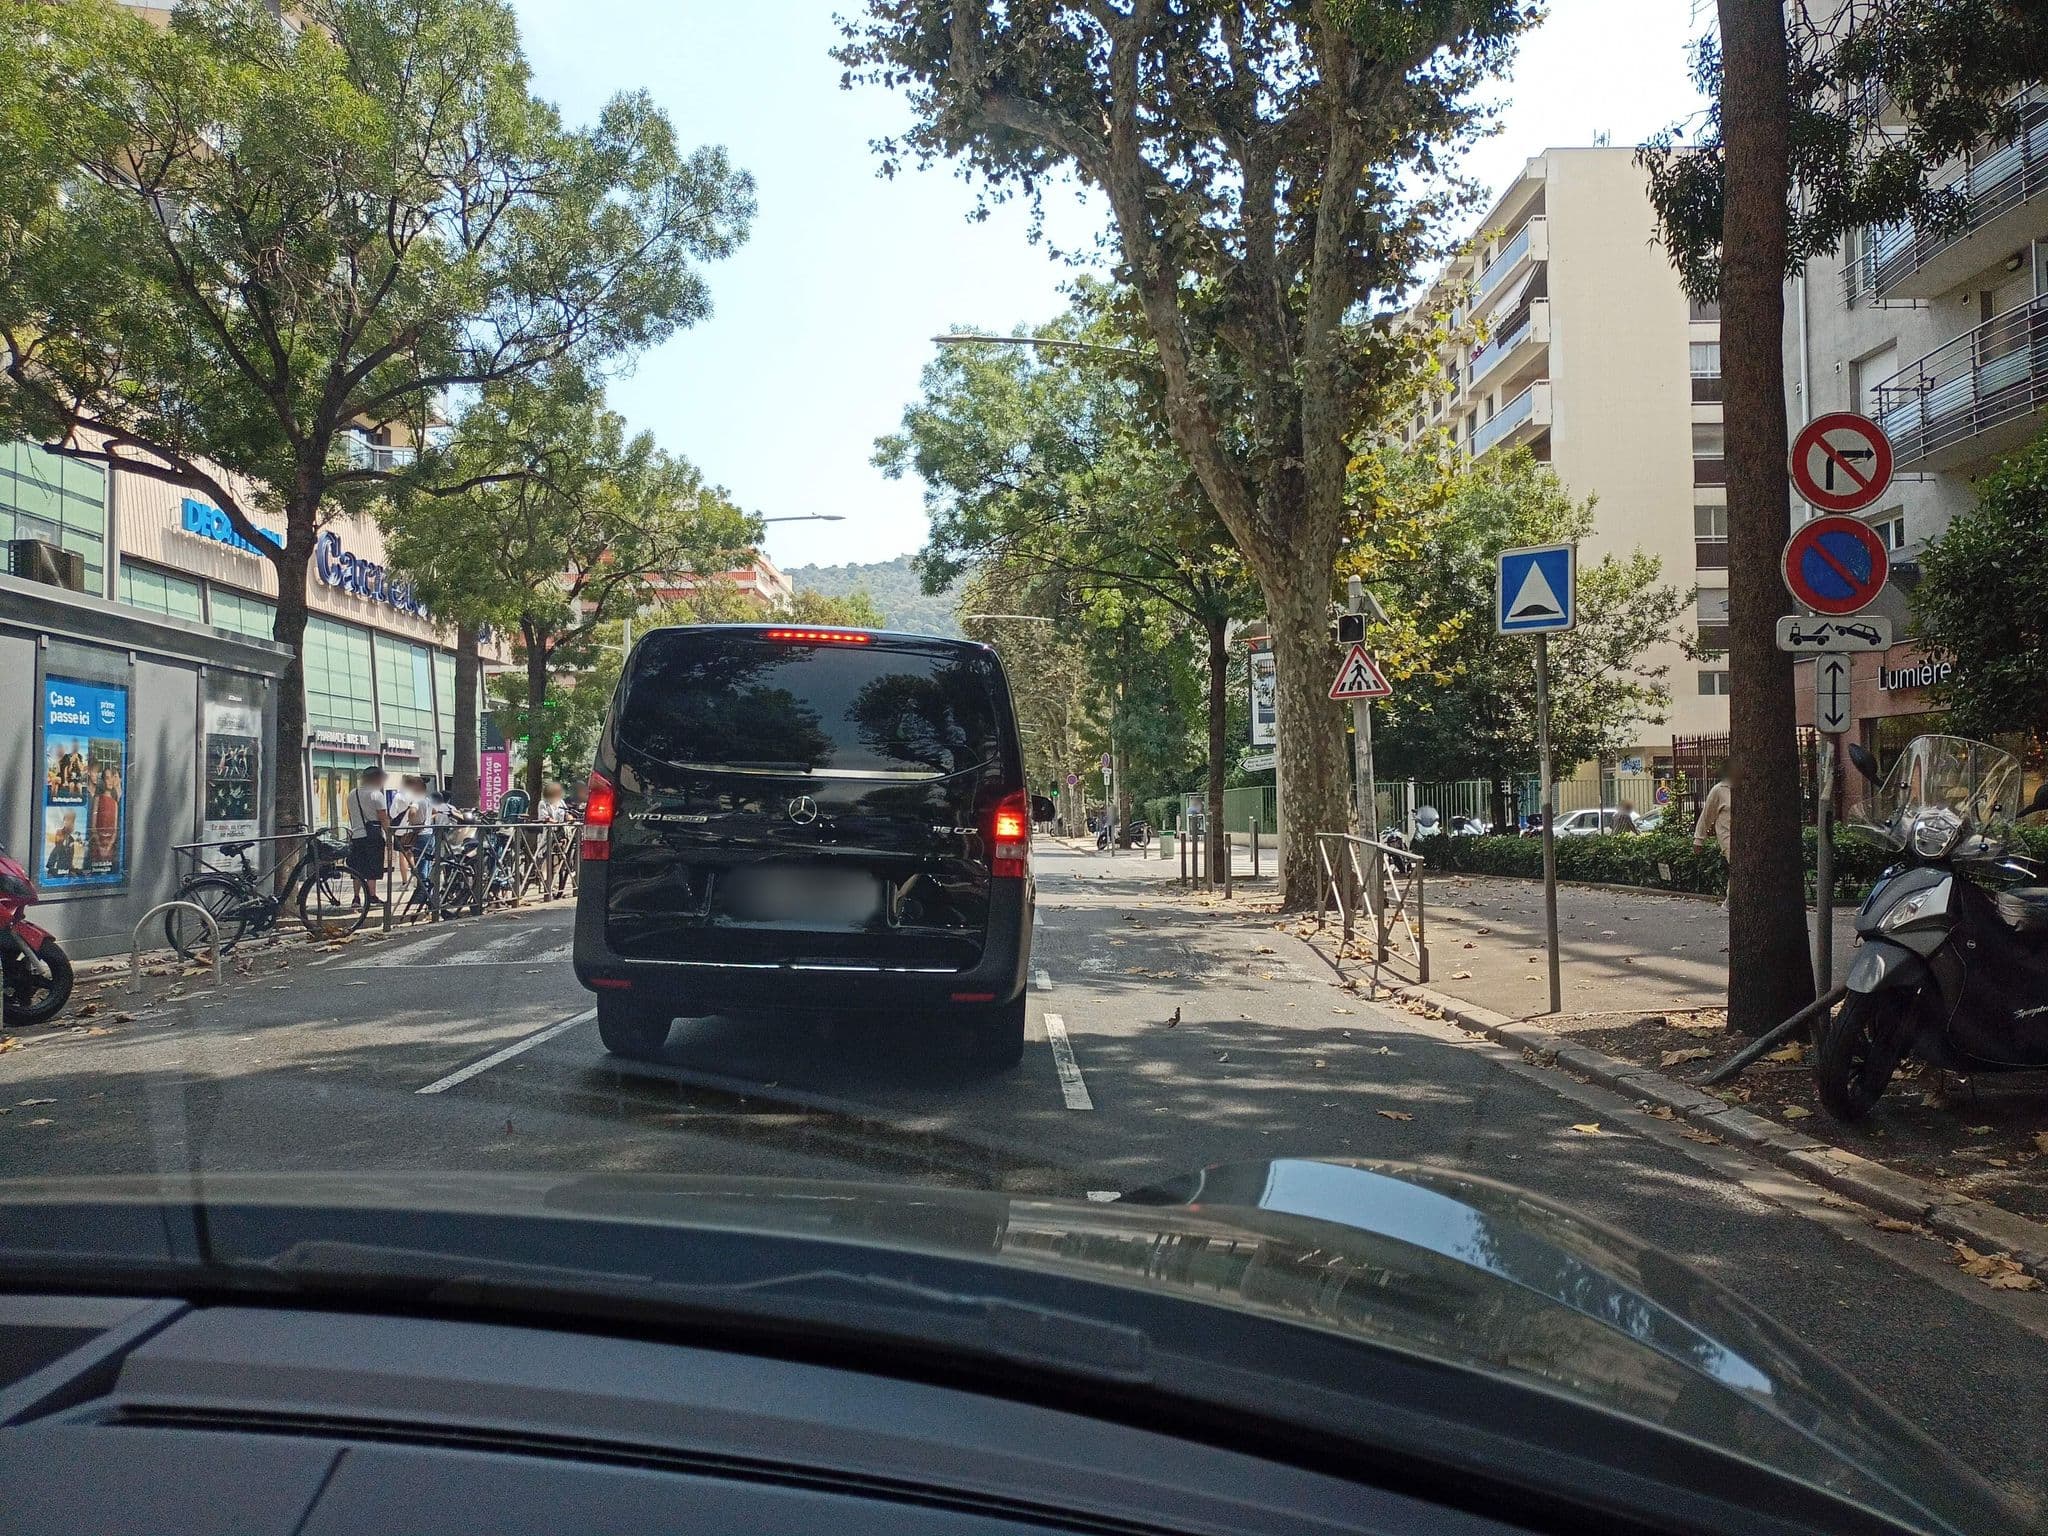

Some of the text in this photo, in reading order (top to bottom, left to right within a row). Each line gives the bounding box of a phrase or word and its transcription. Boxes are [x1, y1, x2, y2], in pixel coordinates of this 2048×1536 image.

[181, 498, 286, 557] DECAN
[316, 530, 430, 617] Carre
[1878, 659, 1952, 691] Lumière
[50, 691, 76, 708] Ça se
[50, 711, 90, 725] passe ici
[493, 762, 502, 810] COVID-19
[628, 812, 662, 820] VITO
